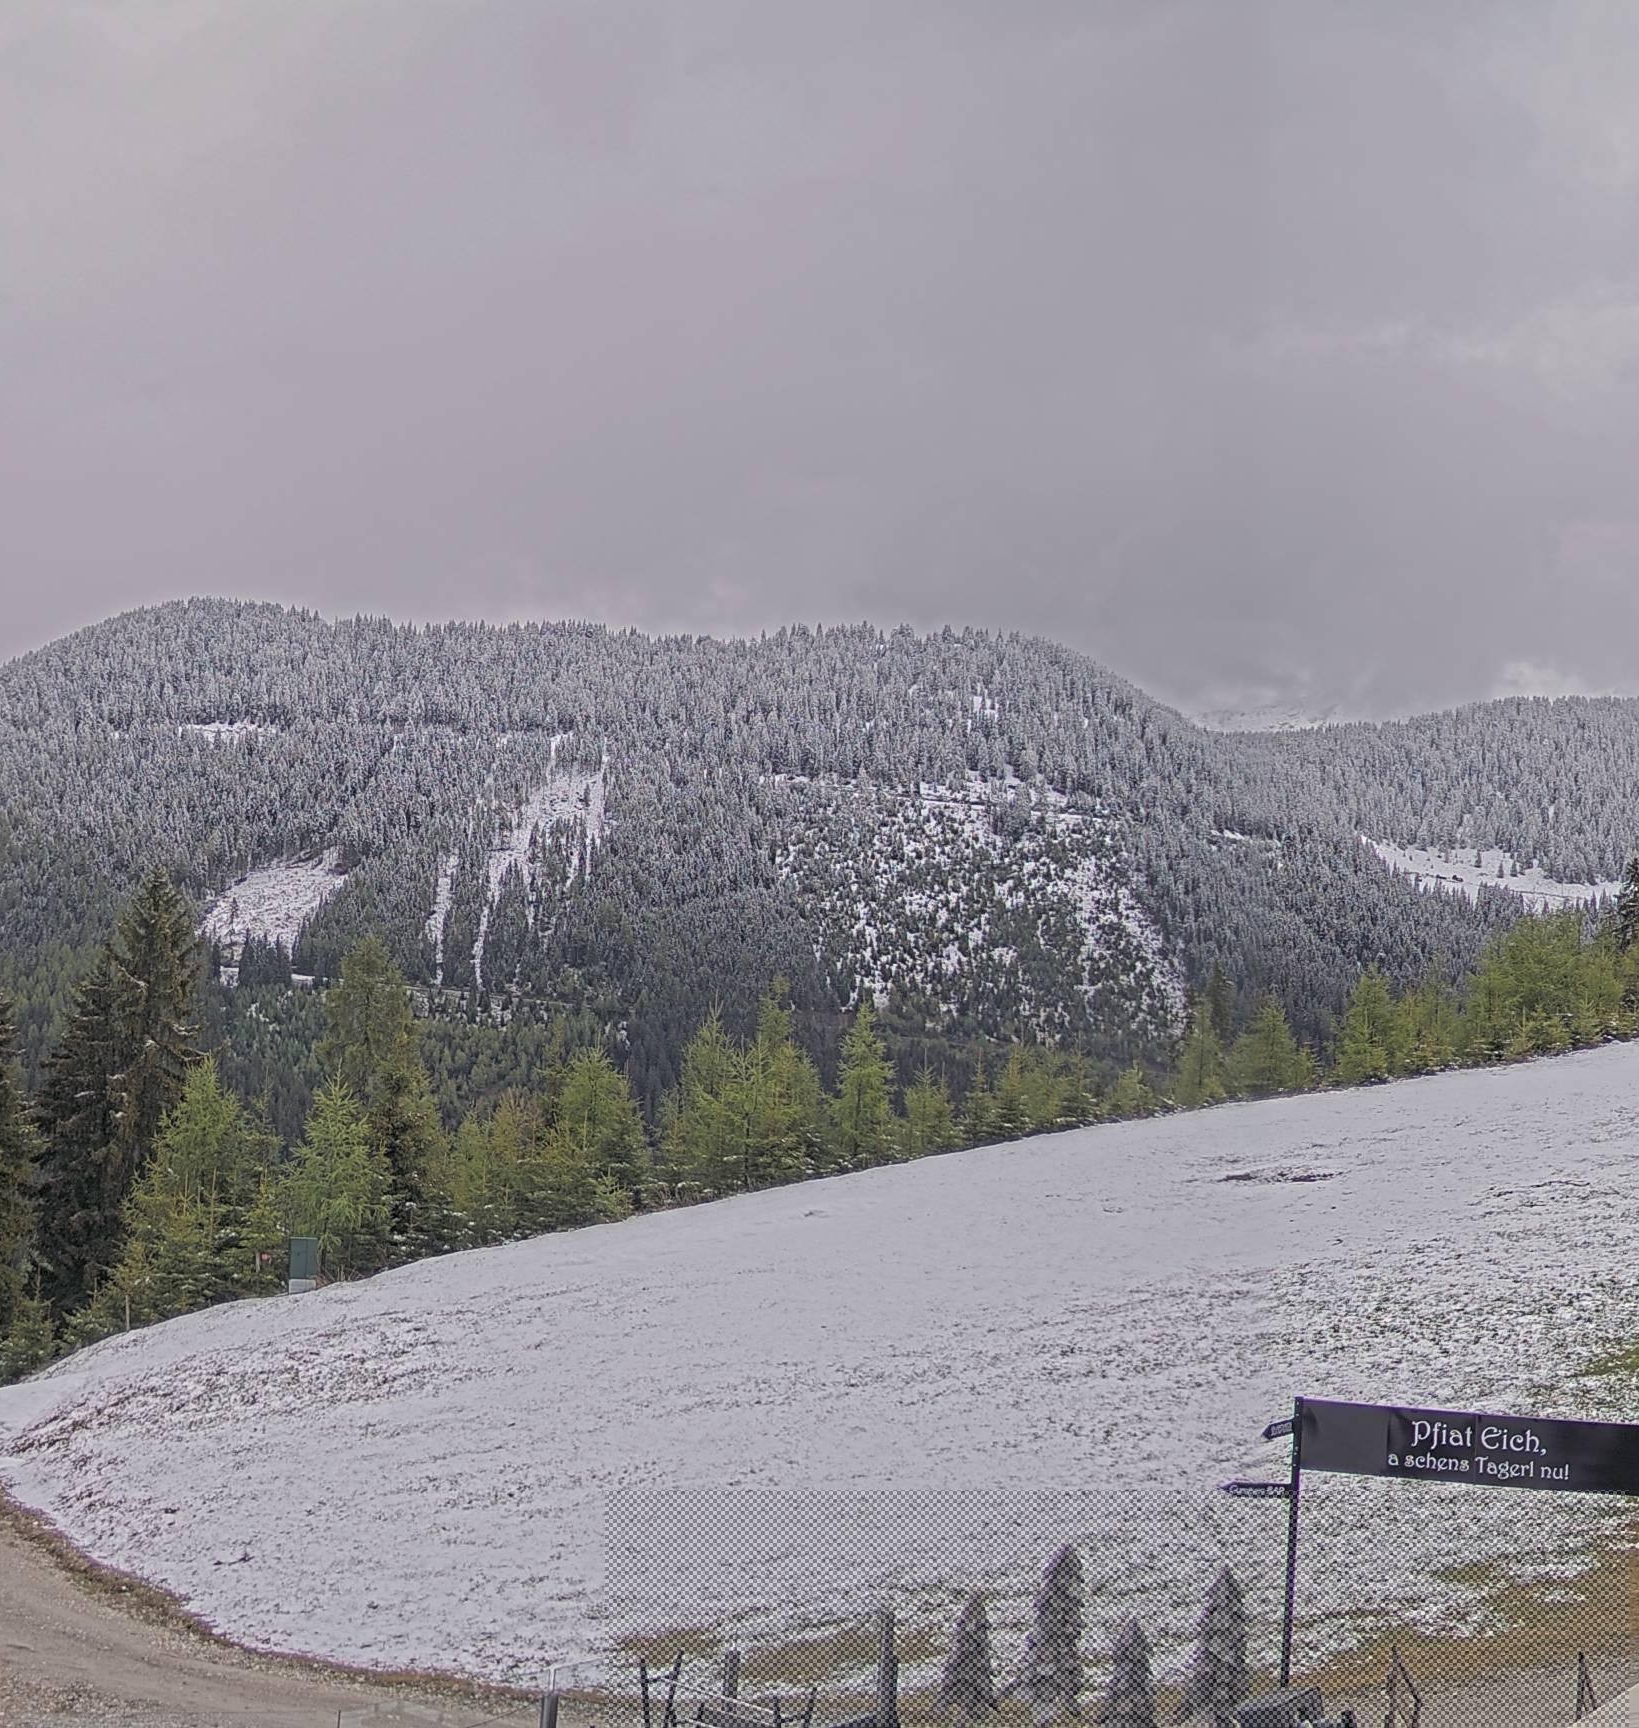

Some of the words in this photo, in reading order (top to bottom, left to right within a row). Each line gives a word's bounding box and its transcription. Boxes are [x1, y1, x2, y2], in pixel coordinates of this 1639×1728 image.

[1411, 1420, 1473, 1449] Pfiat
[1481, 1426, 1547, 1456] Eich,
[1388, 1453, 1399, 1467] a
[1404, 1452, 1470, 1472] schens
[1475, 1456, 1534, 1480] Tagerl
[1540, 1464, 1570, 1481] nu!
